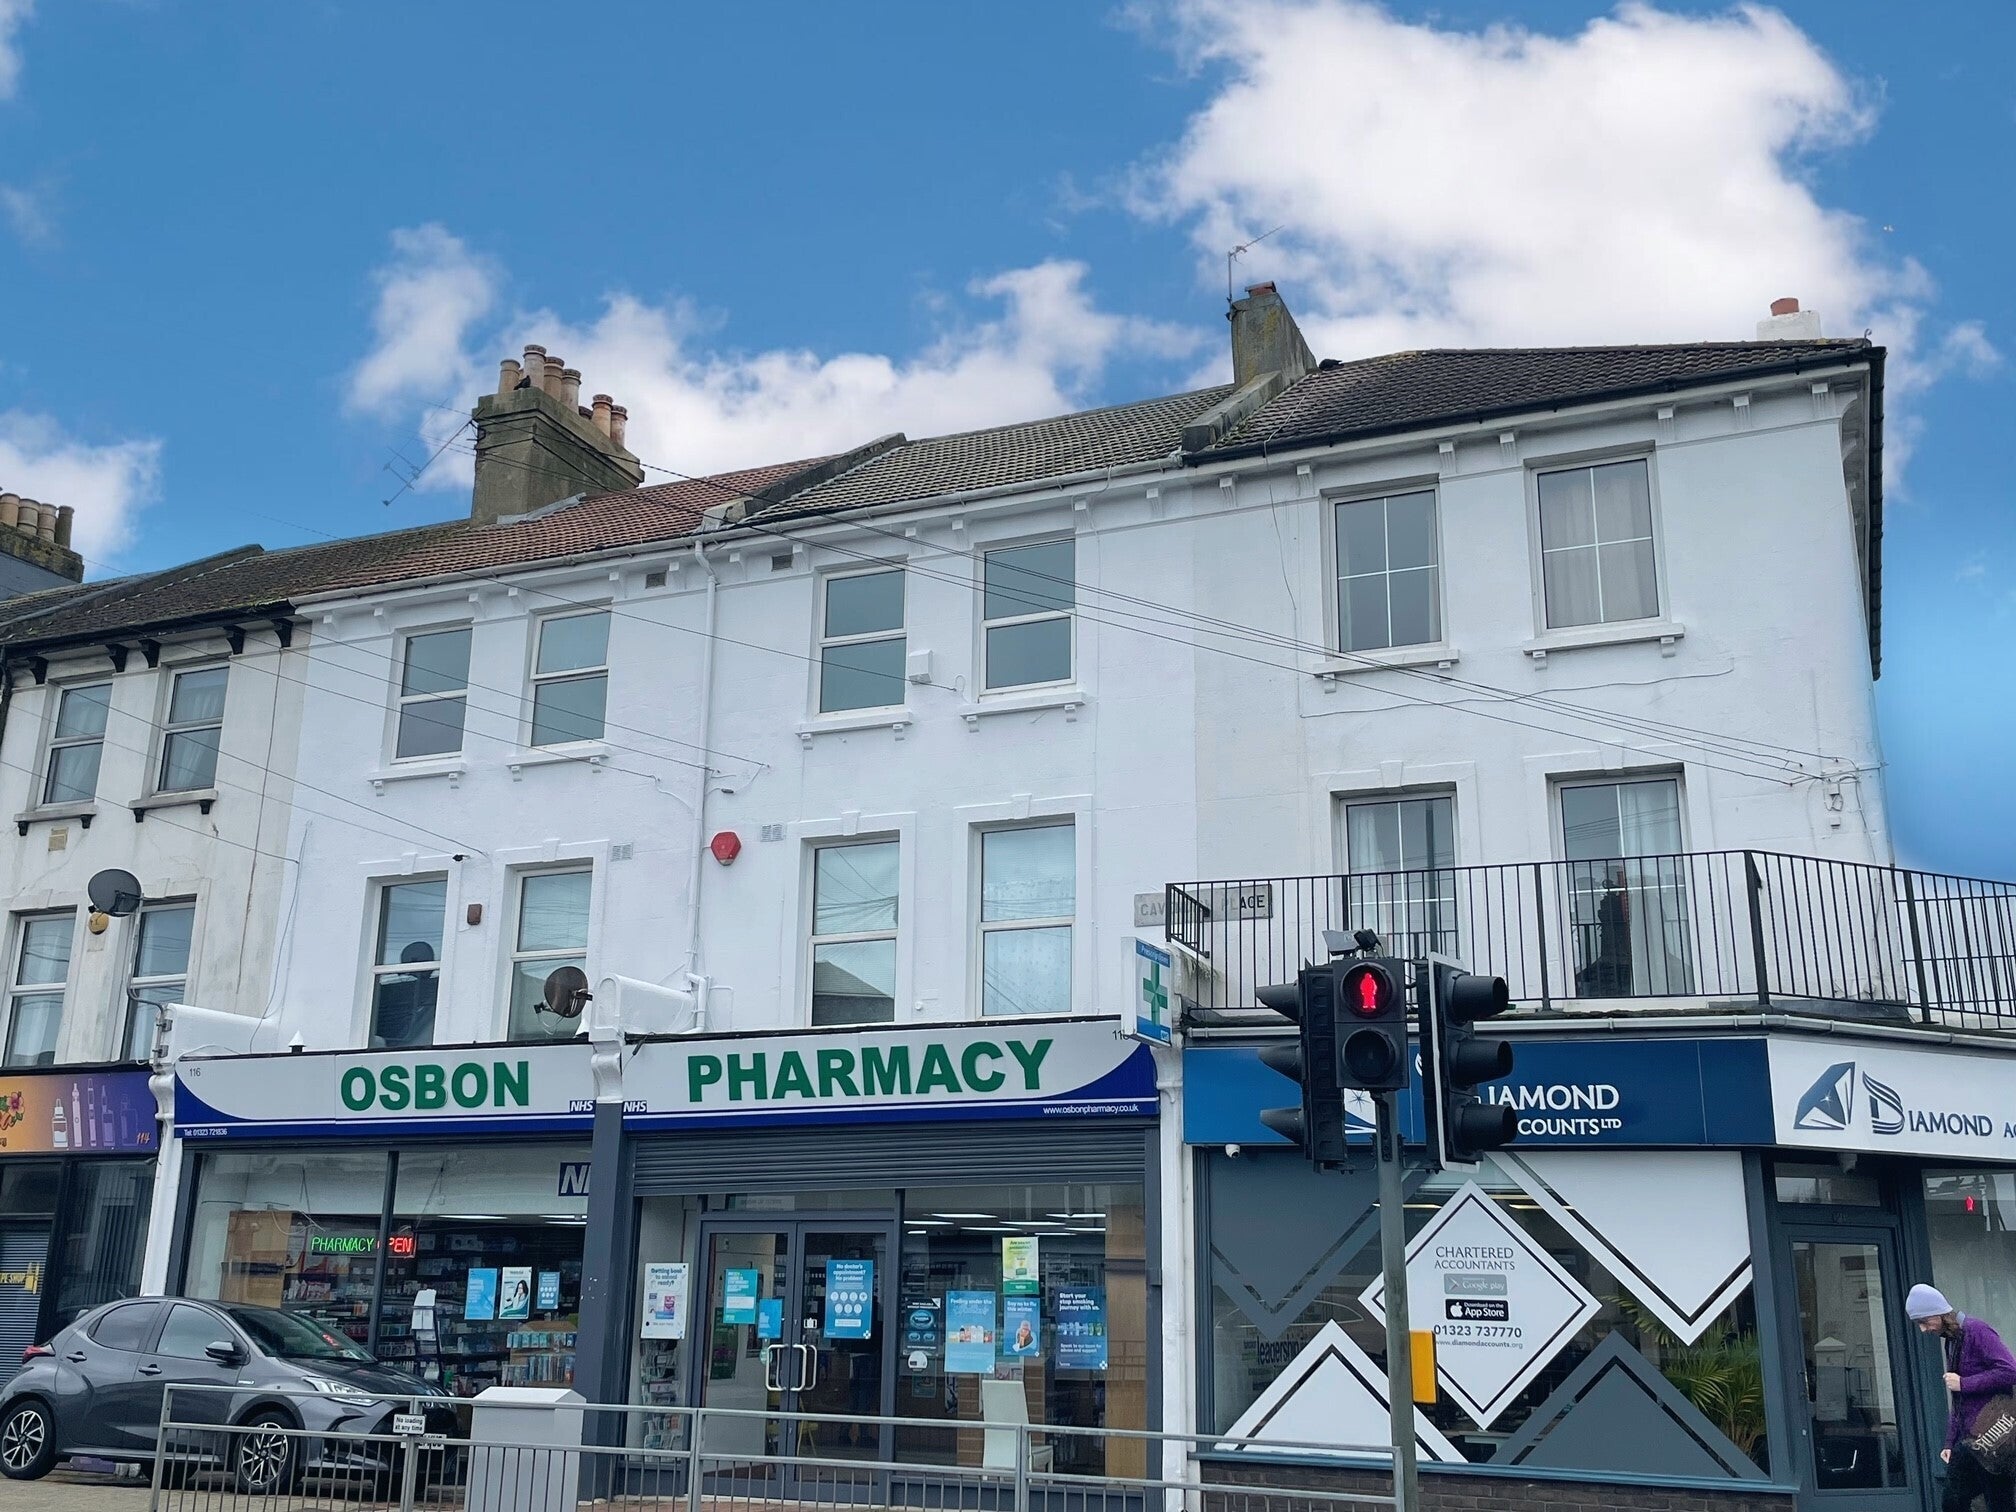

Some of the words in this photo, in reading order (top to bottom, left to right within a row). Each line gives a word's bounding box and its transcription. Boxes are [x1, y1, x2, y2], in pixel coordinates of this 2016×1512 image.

[189, 1067, 201, 1077] 116
[687, 1038, 1054, 1103] PHARMACY
[340, 1060, 529, 1112] OSBON
[1487, 1084, 1620, 1111] IAMOND
[1862, 1070, 1993, 1137] DIAMOND
[570, 1100, 594, 1112] NHS
[623, 1101, 647, 1113] NHS
[1043, 1103, 1139, 1115] www.osbonpharmacy.co.uk
[1517, 1118, 1600, 1136] COUNTS
[1600, 1118, 1622, 1129] LTD
[136, 1132, 151, 1144] 114
[311, 1236, 375, 1252] PHARMACY
[1435, 1246, 1514, 1259] CHARTERED
[1434, 1260, 1516, 1270] ACCOUNTANTS
[1462, 1279, 1488, 1291] Google
[1490, 1281, 1505, 1291] play
[1464, 1307, 1482, 1318] App
[1483, 1307, 1505, 1317] Store
[1433, 1324, 1472, 1336] 01323
[1475, 1326, 1522, 1338] 737770
[1435, 1339, 1524, 1350] www.diamondaccounts.org
[404, 1417, 423, 1425] loading
